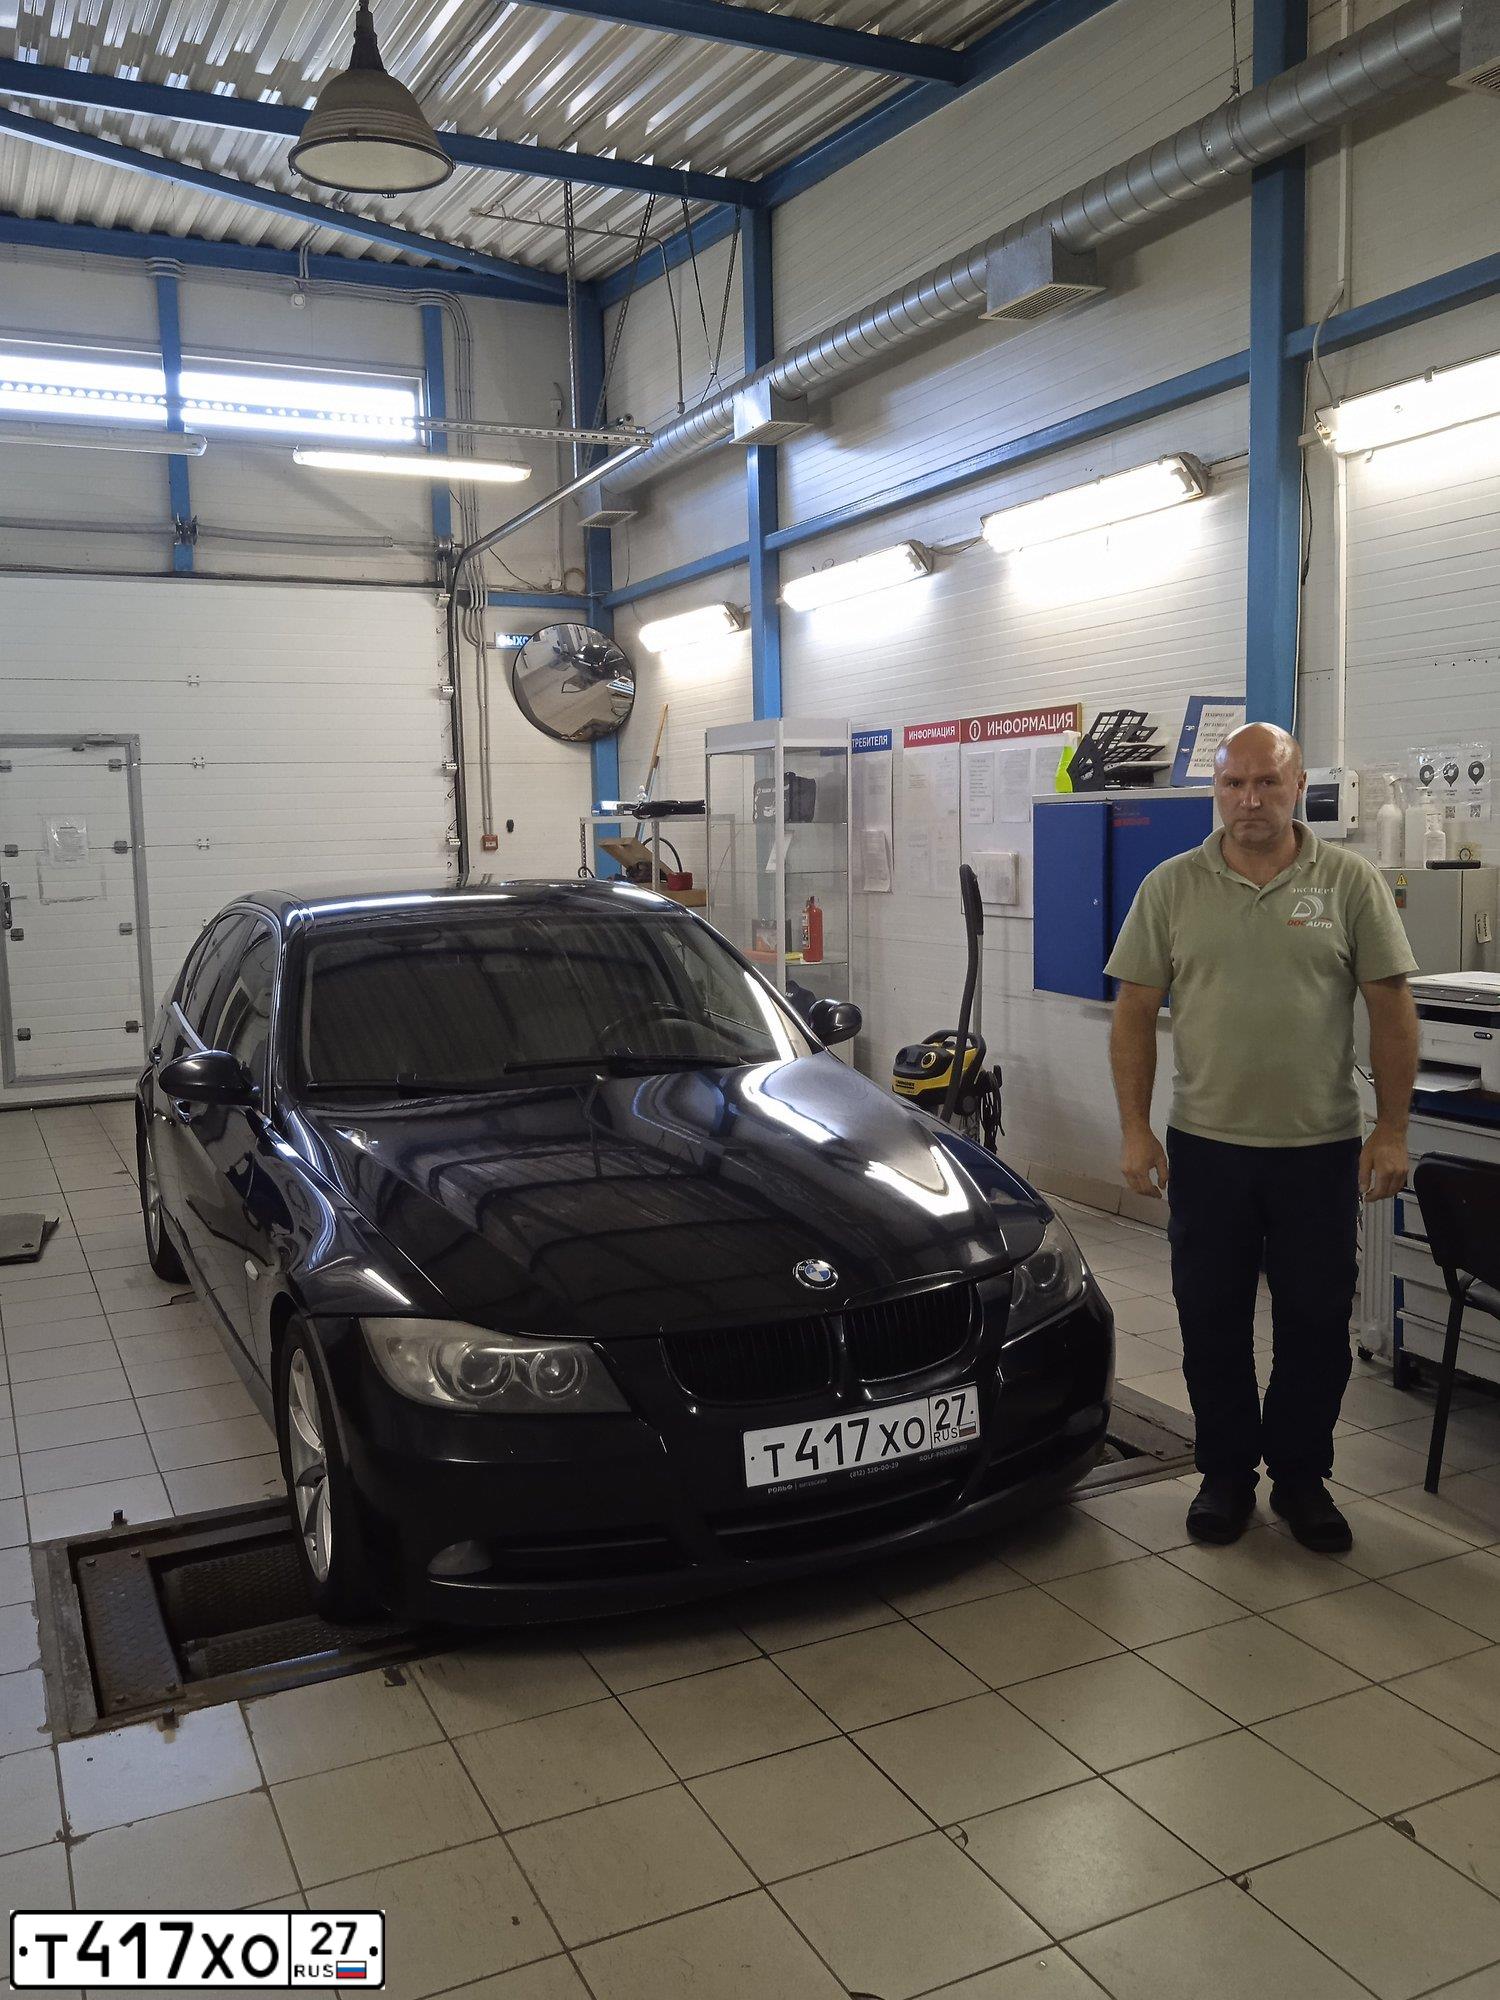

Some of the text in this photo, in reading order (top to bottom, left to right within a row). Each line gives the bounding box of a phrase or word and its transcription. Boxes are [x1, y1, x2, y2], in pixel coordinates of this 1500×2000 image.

[908, 726, 956, 741] ИНФОРМАЦИЯ
[987, 711, 1074, 737] ИНФОРМАЦИЯ
[934, 1392, 967, 1431] 27
[933, 1427, 959, 1444] RUS
